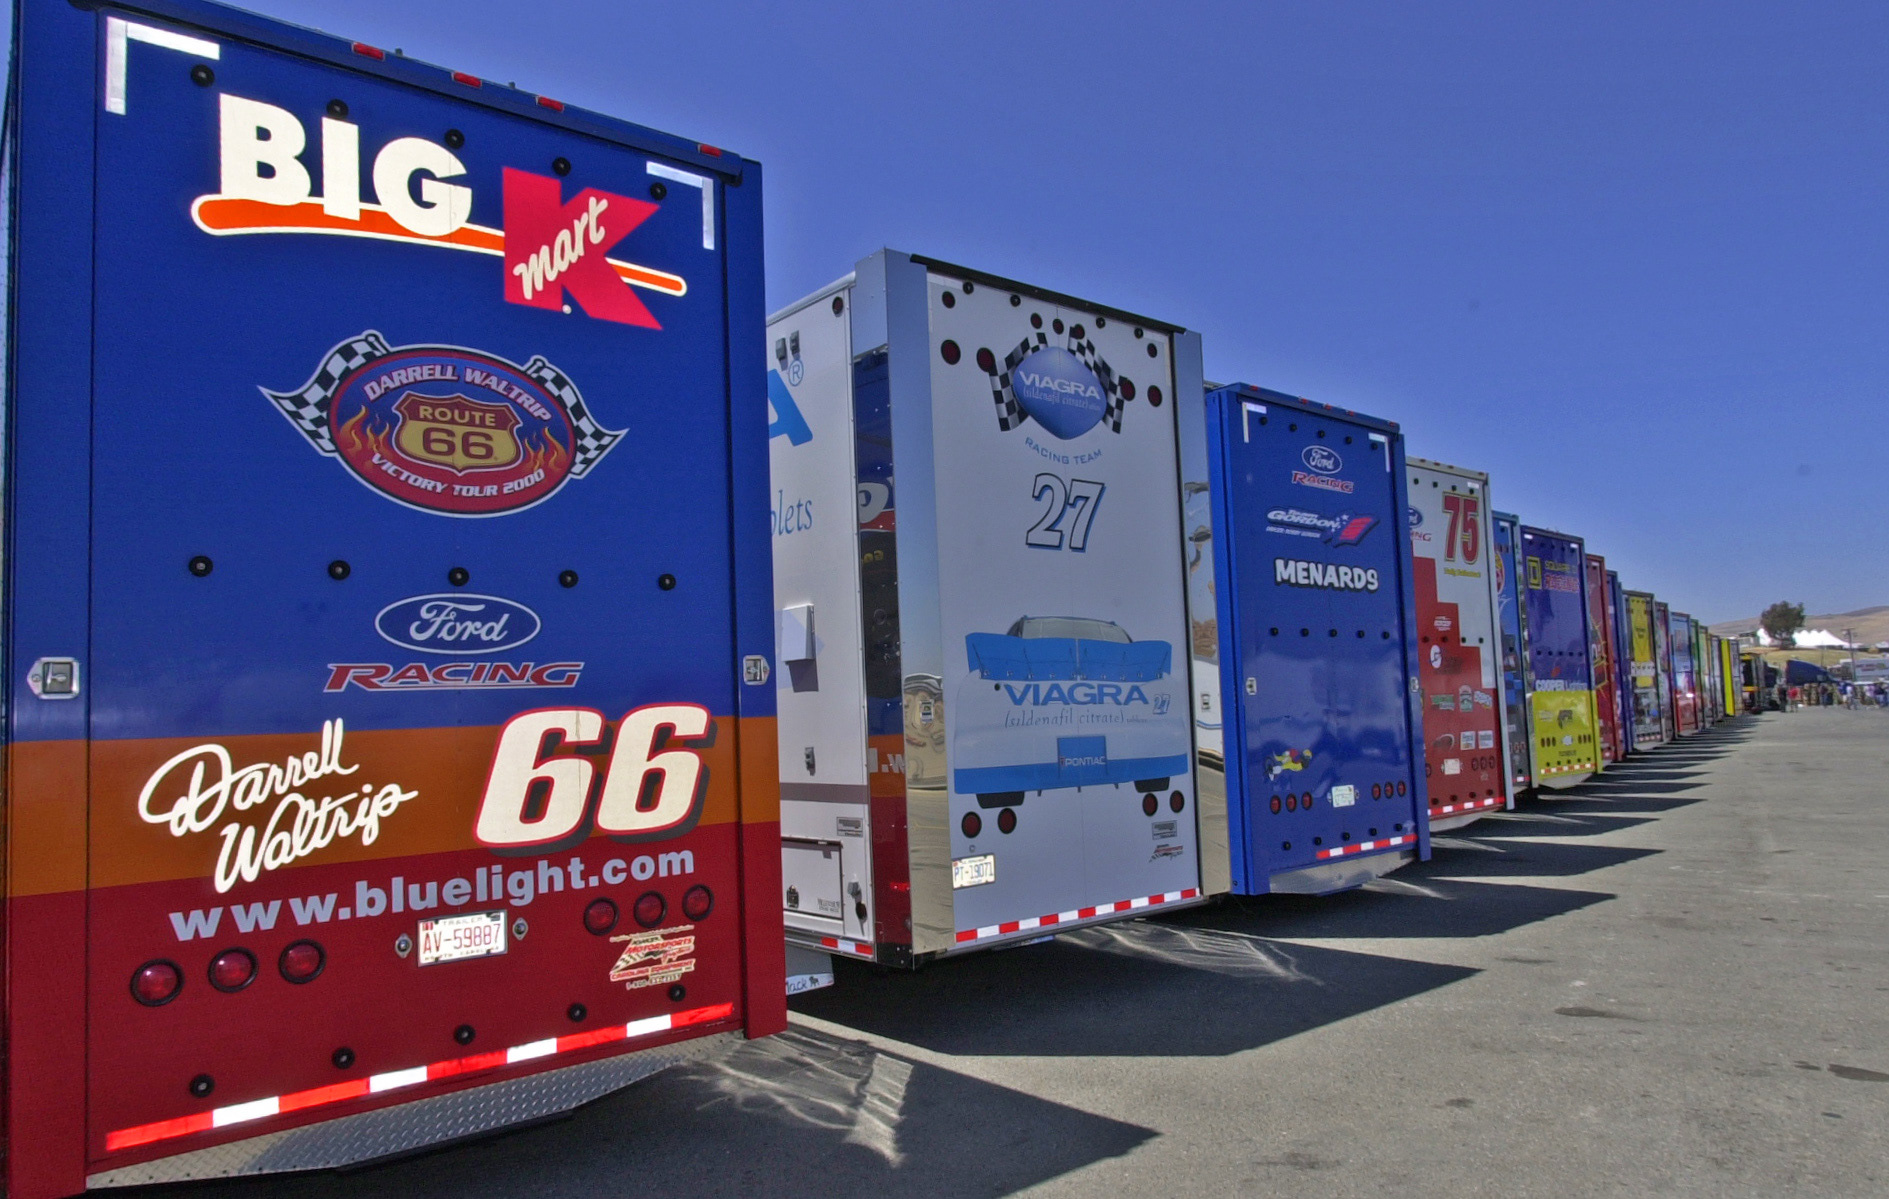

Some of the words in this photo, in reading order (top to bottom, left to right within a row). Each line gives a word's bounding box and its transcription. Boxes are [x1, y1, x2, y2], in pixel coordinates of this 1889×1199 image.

[219, 92, 472, 237] BIG
[361, 364, 460, 404] DARRELL
[463, 366, 552, 423] WALTRIP
[1018, 370, 1102, 402] VIAGRA
[419, 404, 497, 427] ROUTE
[421, 427, 494, 460] 66
[1024, 436, 1070, 465] RACING
[1073, 448, 1103, 465] TEAM
[1309, 448, 1335, 470] Ford
[371, 453, 448, 493] VICTORY
[452, 483, 499, 497] TOUR
[502, 468, 546, 493] 2000
[1291, 470, 1355, 494] RACING
[1025, 472, 1107, 553] 27
[1442, 491, 1479, 565] 75
[1275, 559, 1379, 592] MENARDS
[409, 601, 509, 641] Ford
[323, 662, 585, 692] RACING
[1003, 682, 1150, 707] VIAGRA
[138, 717, 360, 837] Darrell
[474, 703, 716, 850] 66
[1065, 755, 1107, 768] PONTIAC
[212, 783, 418, 894] Waltrip
[423, 923, 502, 954] AV-59887
